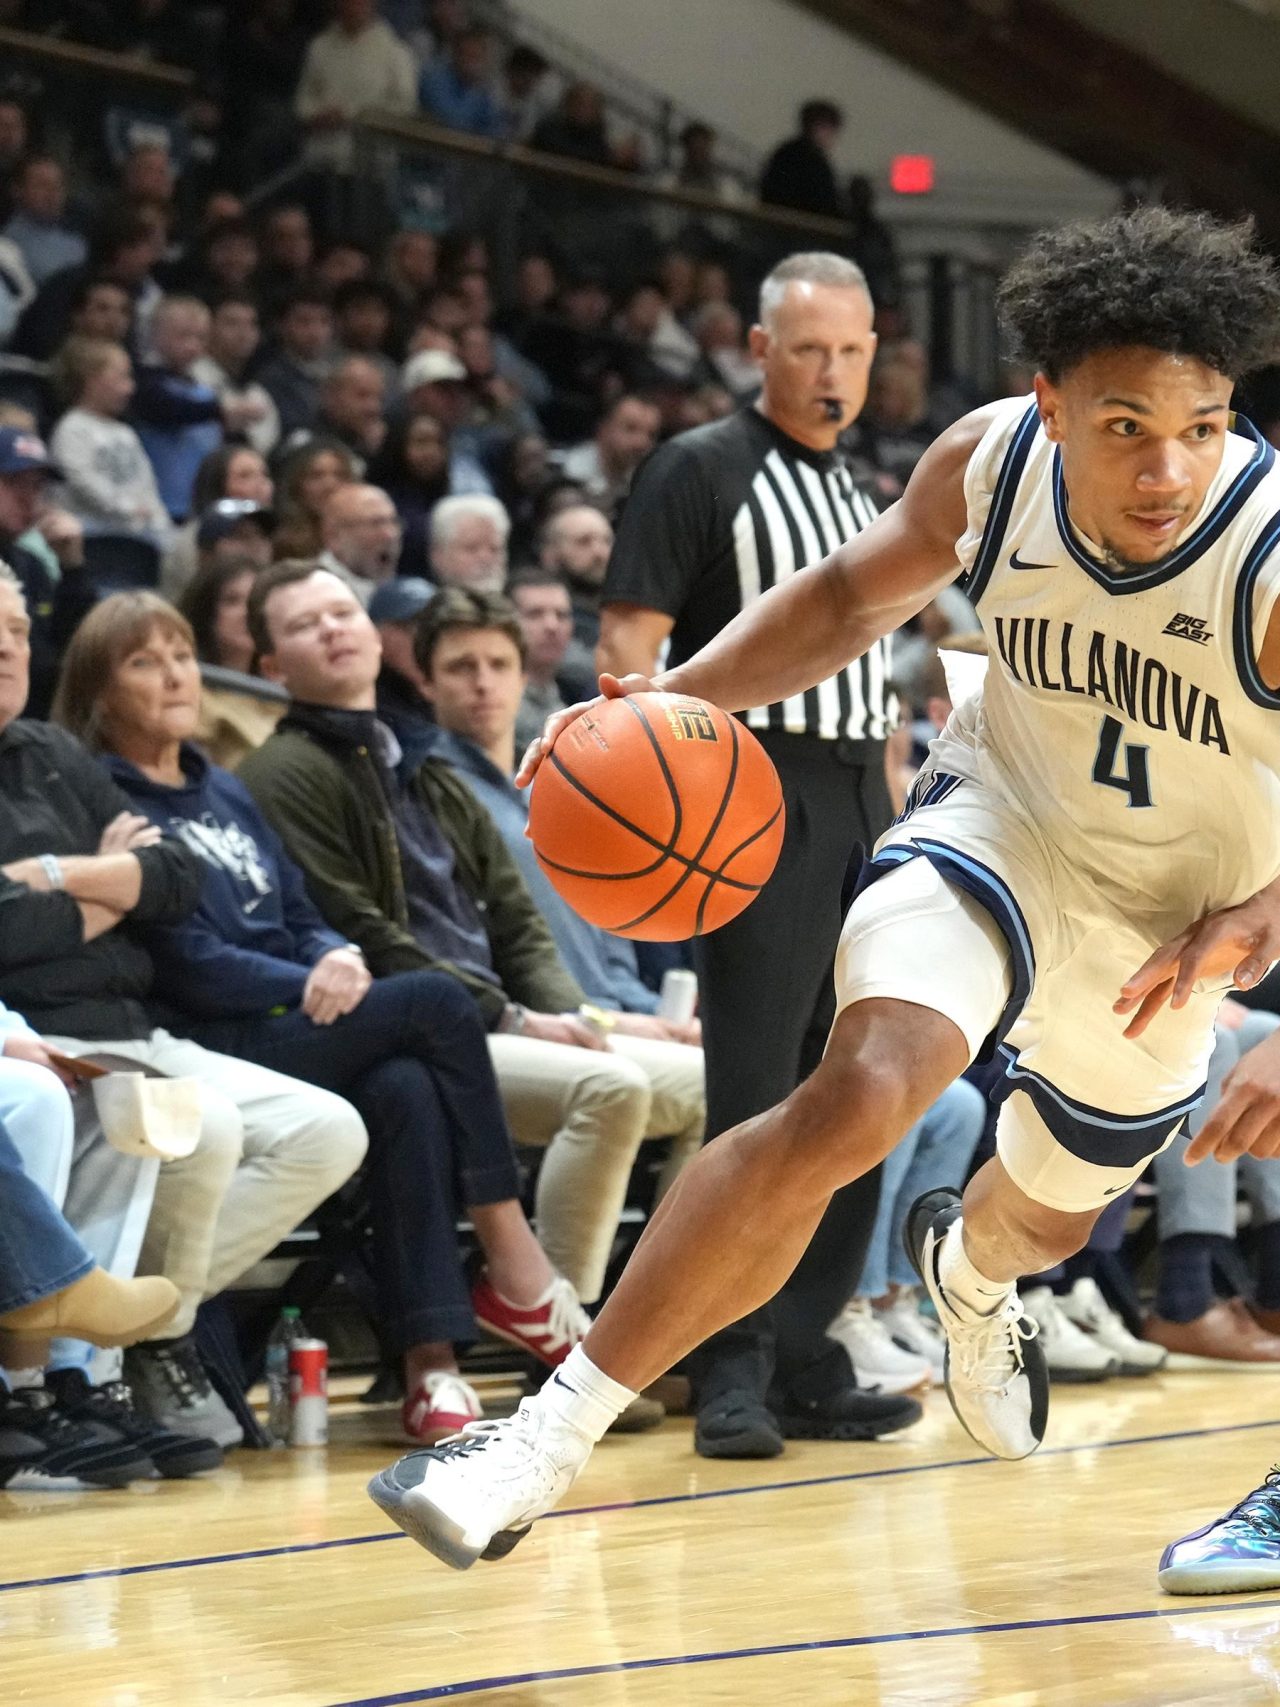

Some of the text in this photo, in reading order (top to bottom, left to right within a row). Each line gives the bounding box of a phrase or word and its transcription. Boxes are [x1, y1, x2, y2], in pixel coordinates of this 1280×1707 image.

[1165, 621, 1214, 642] EAST
[1171, 612, 1208, 630] BIG
[994, 616, 1231, 756] VILLANOVA
[1091, 713, 1157, 808] 4
